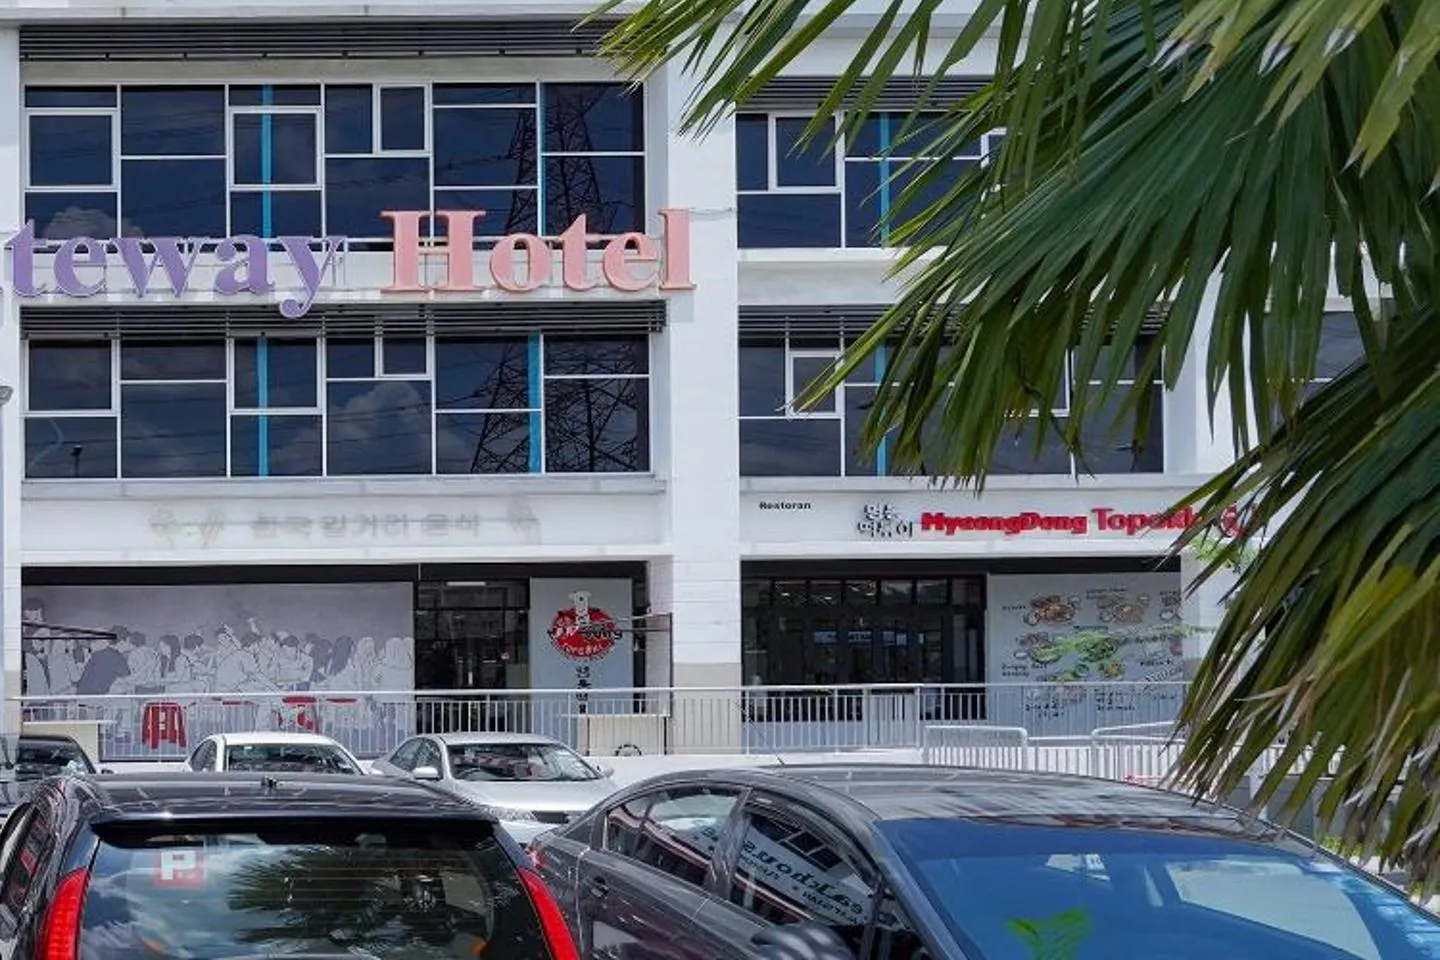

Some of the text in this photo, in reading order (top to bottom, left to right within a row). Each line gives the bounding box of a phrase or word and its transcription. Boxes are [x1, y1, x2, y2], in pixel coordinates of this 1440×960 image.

[380, 207, 697, 295] Hotel
[760, 500, 812, 510] Restoran
[161, 850, 196, 881] P
